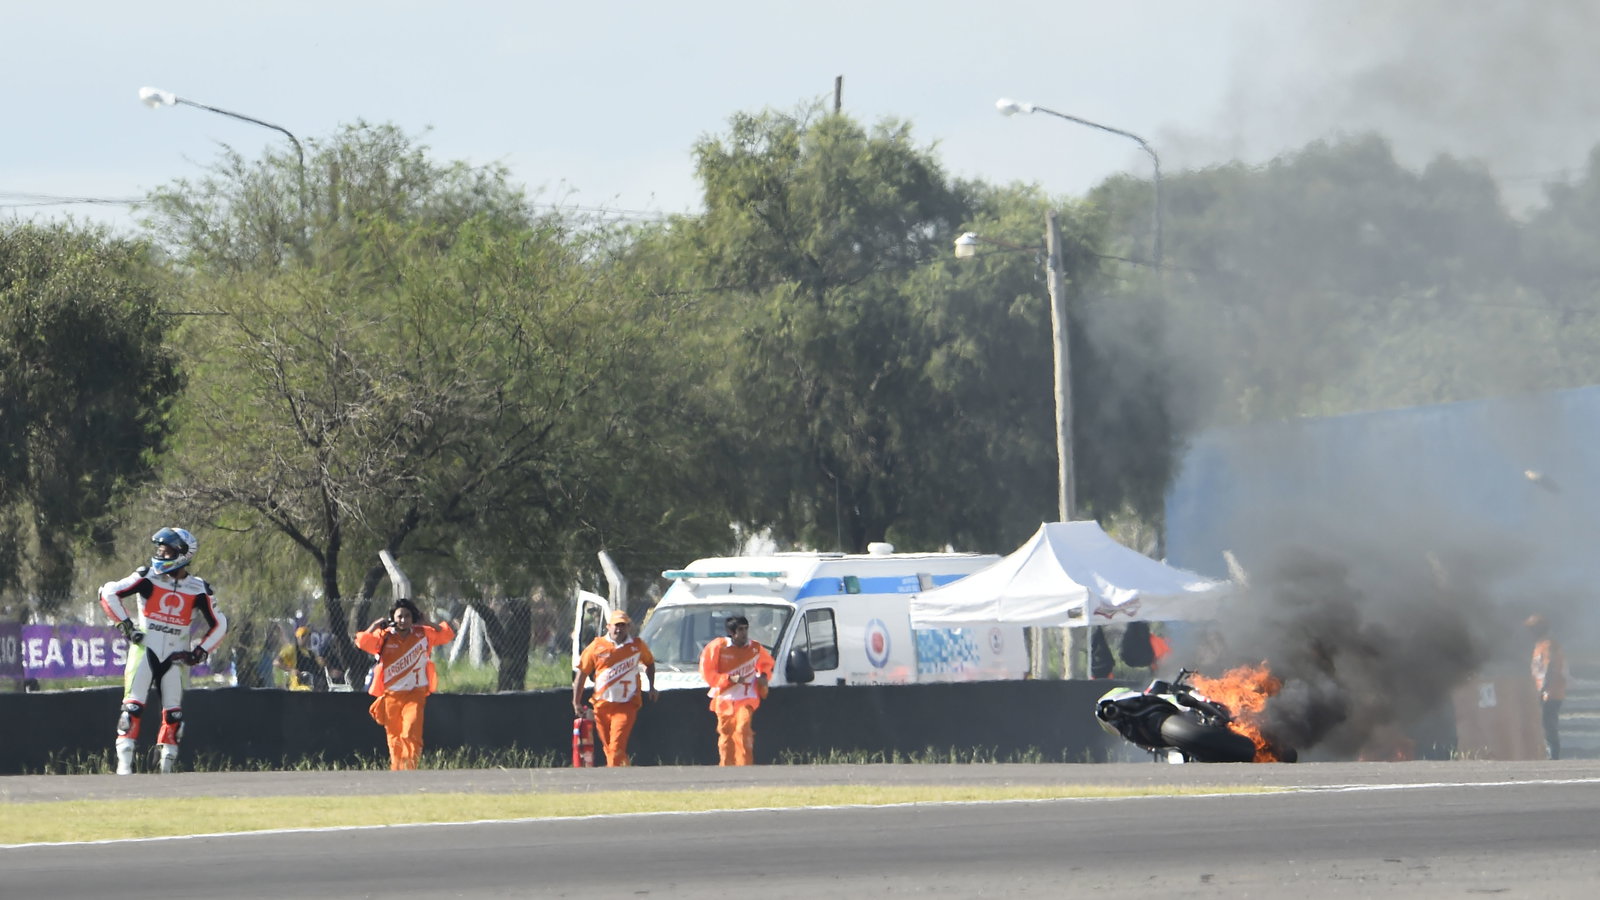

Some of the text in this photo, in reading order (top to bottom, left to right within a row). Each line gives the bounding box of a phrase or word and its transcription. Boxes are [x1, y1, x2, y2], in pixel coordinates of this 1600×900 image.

[149, 622, 181, 635] DUCATI
[72, 638, 105, 669] DE
[619, 680, 632, 698] T
